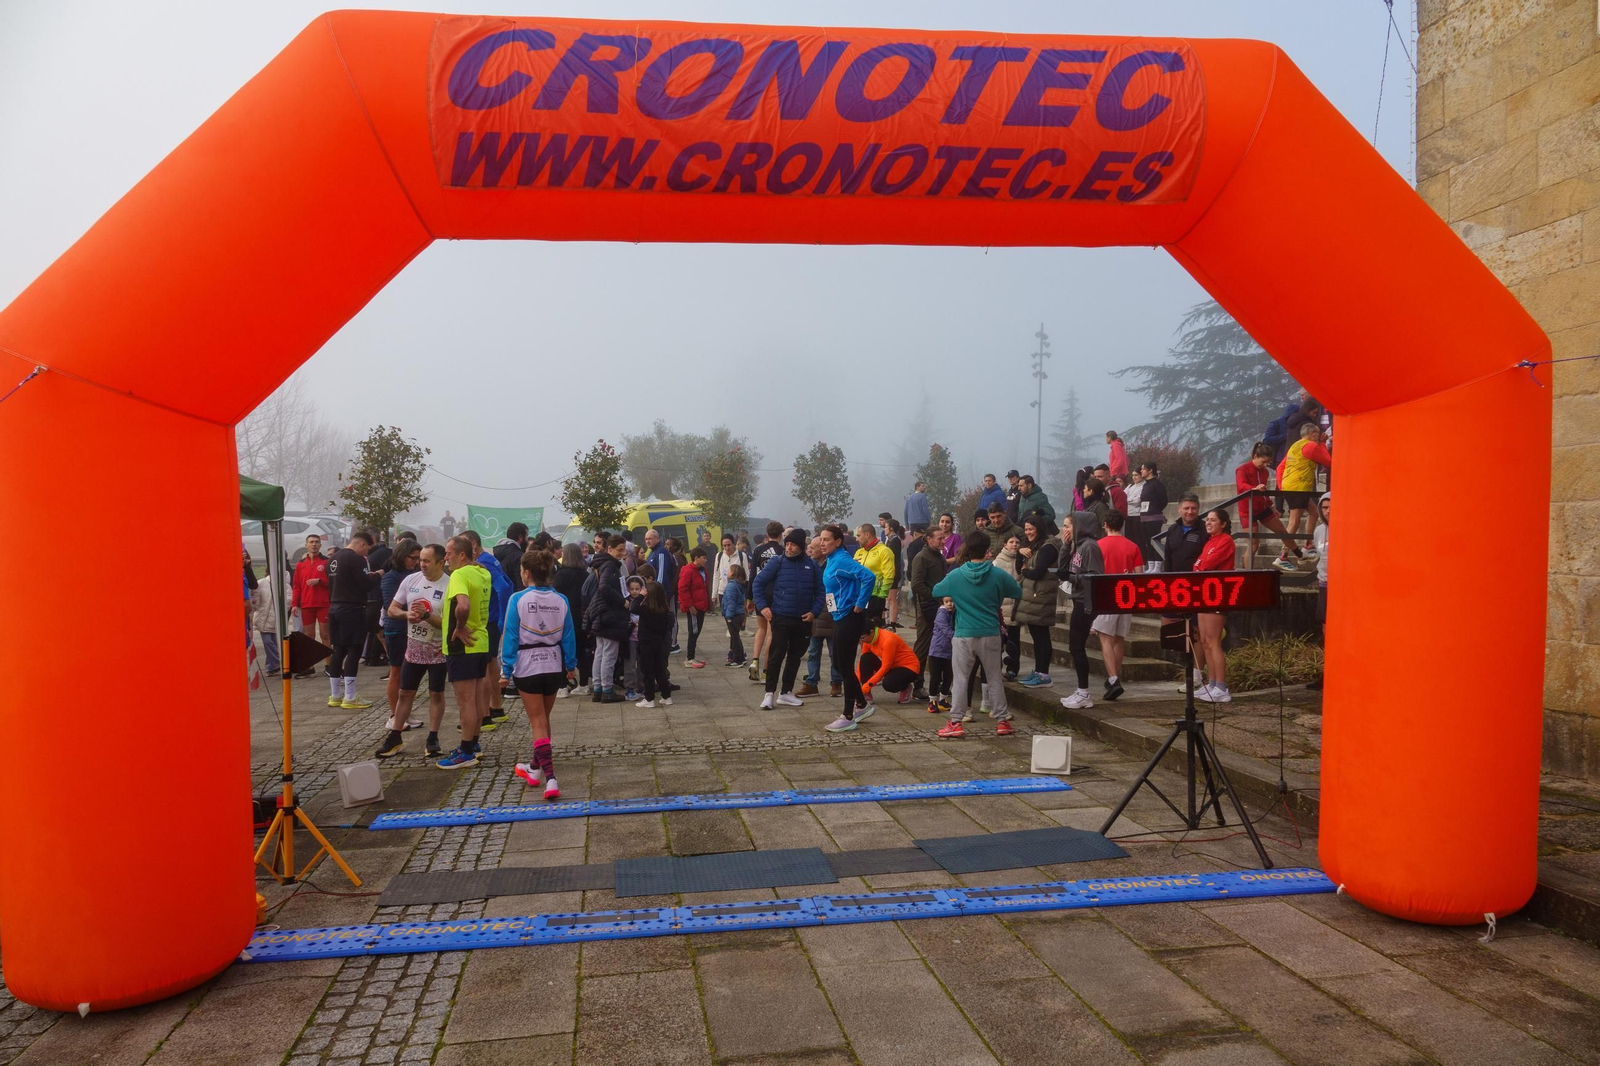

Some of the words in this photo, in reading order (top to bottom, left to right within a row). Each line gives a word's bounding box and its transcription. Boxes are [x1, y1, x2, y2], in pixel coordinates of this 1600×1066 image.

[447, 28, 1186, 132] CRONOTEC
[450, 131, 1175, 203] WWW.CRONOTEC.ES
[1115, 576, 1245, 609] 0:36:07
[411, 624, 428, 637] 555
[885, 782, 968, 792] CRONOTEC
[489, 803, 582, 814] CRONOTEC
[381, 809, 480, 821] CRONOTEC
[1088, 878, 1202, 891] CRONOTEC
[994, 897, 1060, 906] CRONOTEC
[858, 906, 925, 915] CRONOTEC
[715, 915, 784, 925] CRONOTEC
[389, 921, 526, 937] CRONOTEC
[567, 924, 639, 935] CRONOTEC
[249, 928, 374, 946] RONOTEC
